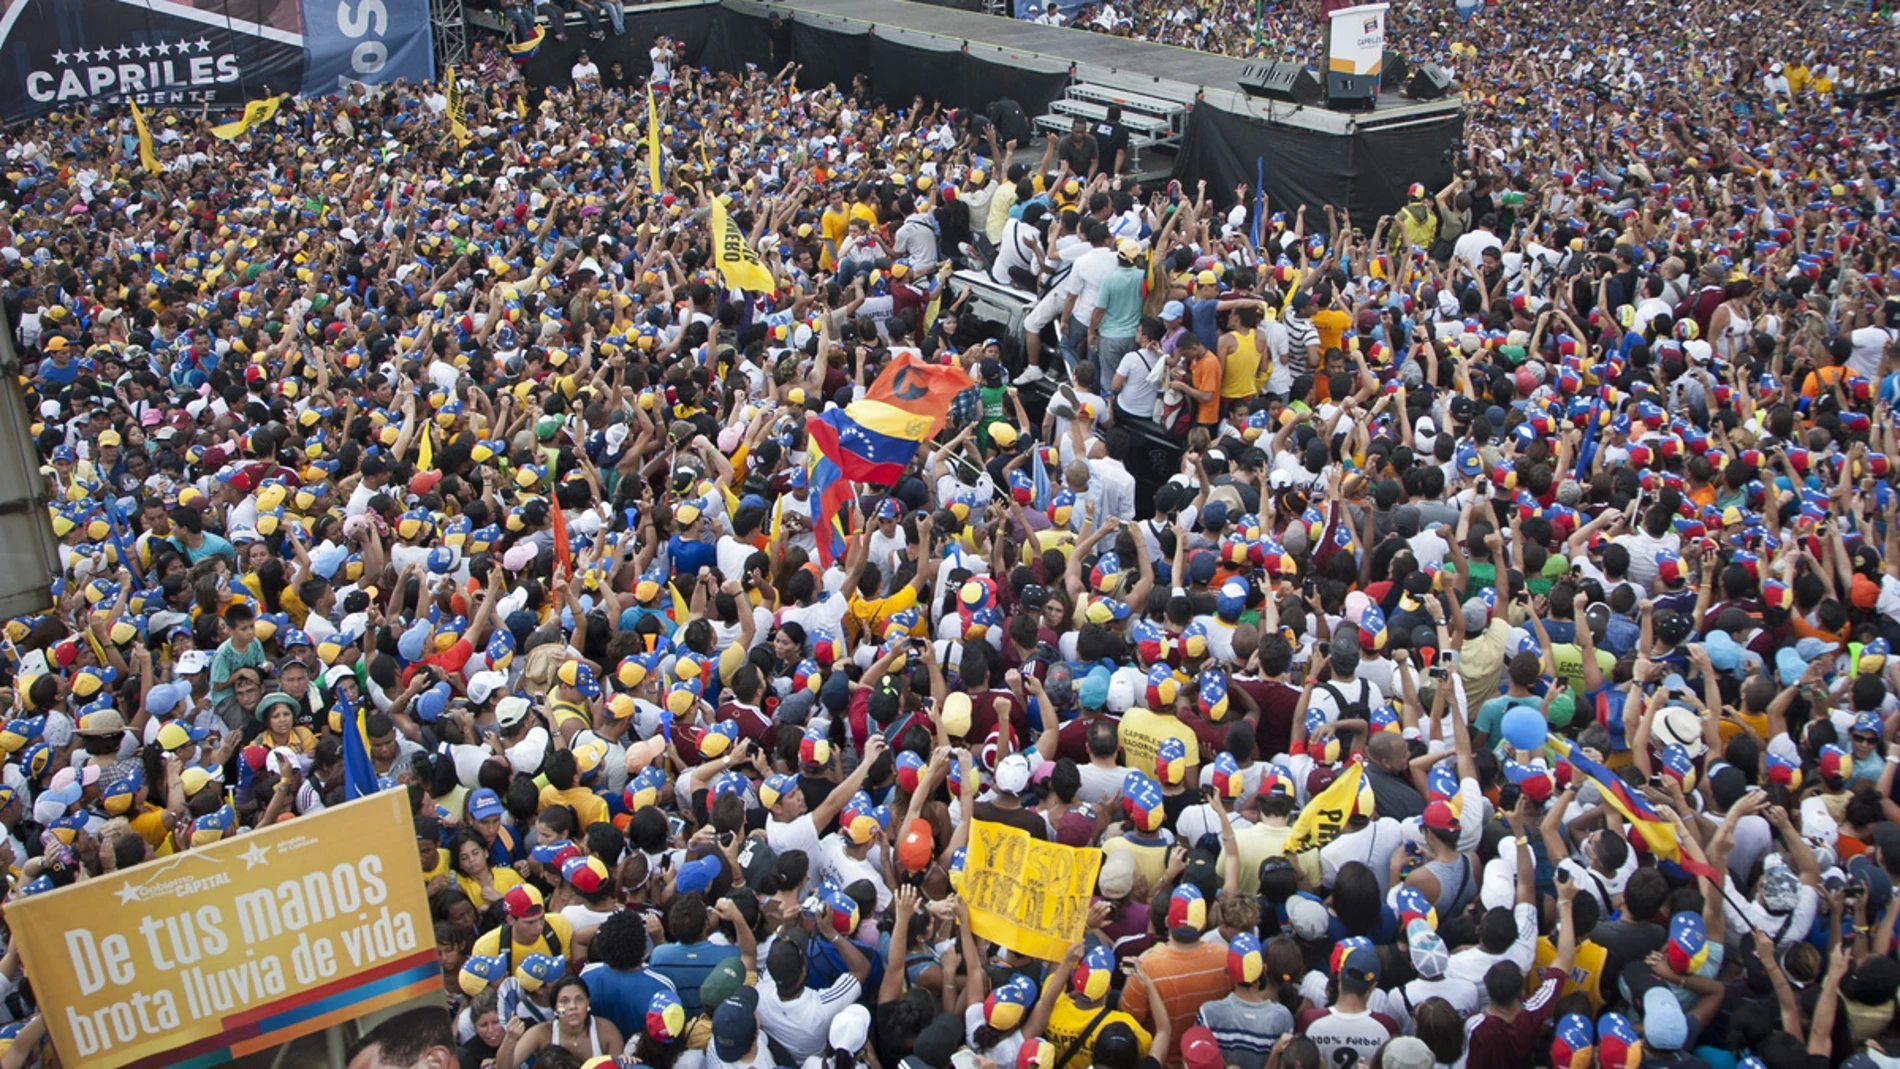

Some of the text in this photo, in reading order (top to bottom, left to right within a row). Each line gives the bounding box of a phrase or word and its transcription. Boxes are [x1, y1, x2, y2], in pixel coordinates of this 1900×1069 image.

[26, 54, 241, 102] CAPRILES
[64, 855, 387, 996] De tus manos
[175, 872, 232, 898] CAPITAL
[66, 905, 417, 1057] brota lluvia de vida
